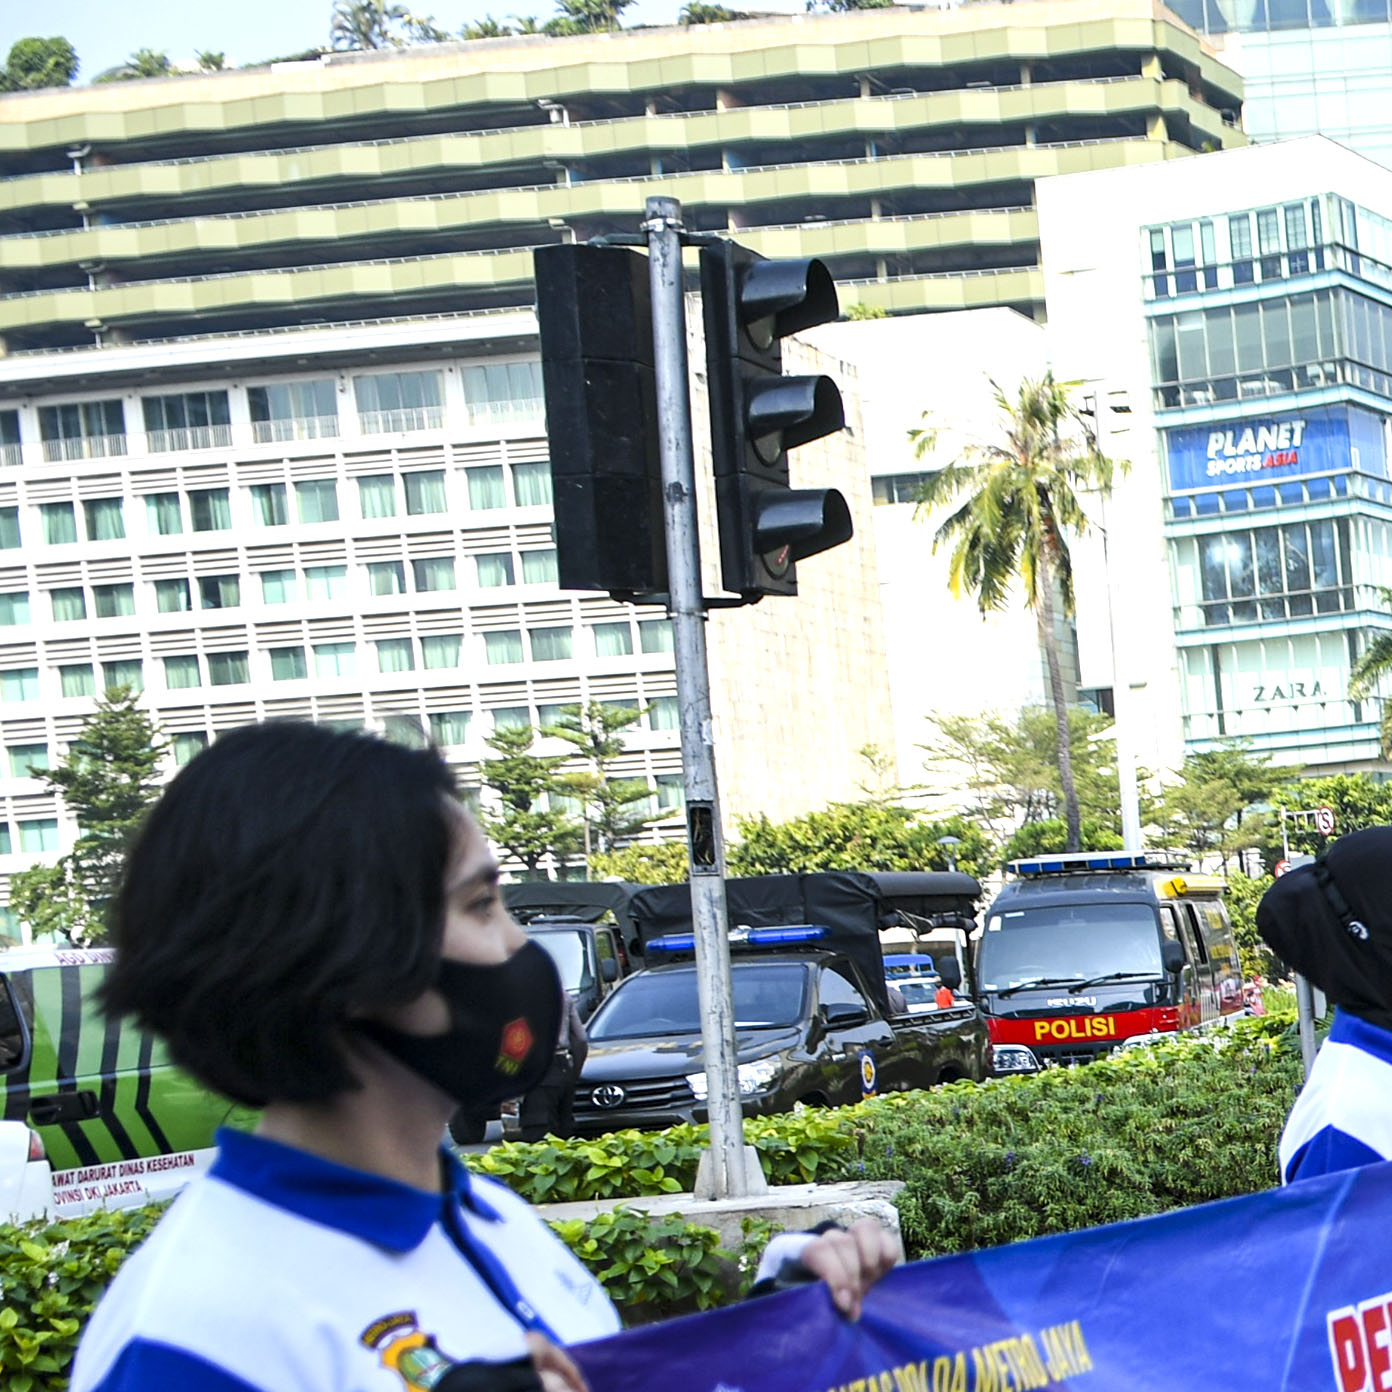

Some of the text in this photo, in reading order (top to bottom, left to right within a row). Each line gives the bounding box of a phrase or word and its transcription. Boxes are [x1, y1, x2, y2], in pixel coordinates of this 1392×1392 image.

[1207, 420, 1306, 459] PLANET
[1207, 451, 1297, 476] SPORTS ASIA
[1253, 680, 1327, 702] ZARA
[1048, 996, 1097, 1008] ISUZU
[1034, 1017, 1116, 1040] POLISI
[78, 1166, 117, 1184] DARURAT
[119, 1162, 144, 1176] DINAS
[147, 1154, 194, 1173] KESEHATAN
[103, 1181, 142, 1198] JAKARTA
[1040, 1321, 1093, 1381] JAYA
